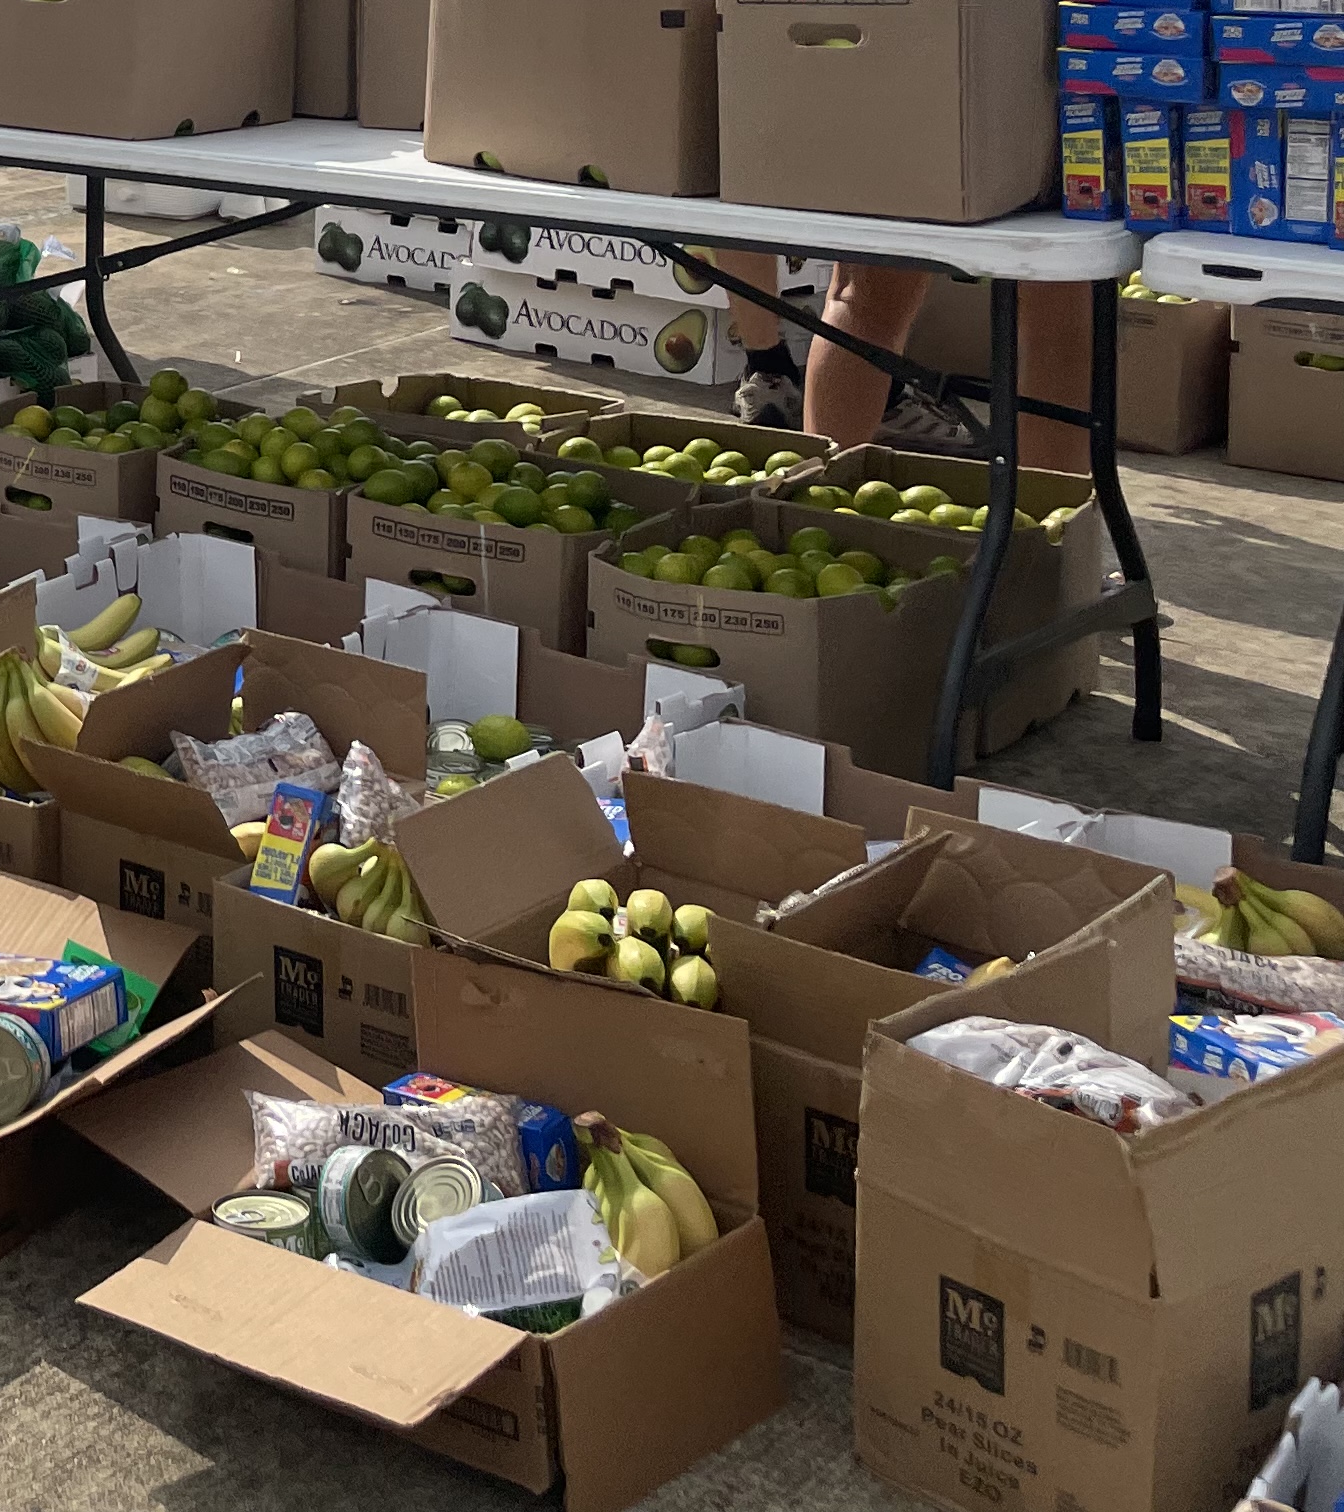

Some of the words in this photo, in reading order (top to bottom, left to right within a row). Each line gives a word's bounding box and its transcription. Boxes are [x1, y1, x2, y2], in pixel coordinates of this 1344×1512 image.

[367, 234, 464, 271] AVOCAD
[535, 227, 668, 268] AVOCADOS
[512, 298, 650, 348] AVOCADOS
[34, 466, 50, 475] 200
[76, 472, 93, 482] 250
[208, 490, 224, 503] 175
[227, 495, 244, 508] 200
[248, 500, 267, 512] 230
[270, 504, 290, 516] 250
[375, 521, 393, 534] 110
[420, 532, 440, 545] 175
[446, 537, 466, 550] 200
[498, 545, 520, 558] 250
[616, 594, 632, 608] 110
[662, 607, 685, 620] 175
[723, 615, 748, 627] 230
[755, 618, 779, 630] 250
[921, 1405, 967, 1440] Pear
[972, 1430, 1039, 1476] Slices
[993, 1420, 1024, 1447] OZ
[964, 1451, 1021, 1491] Juice
